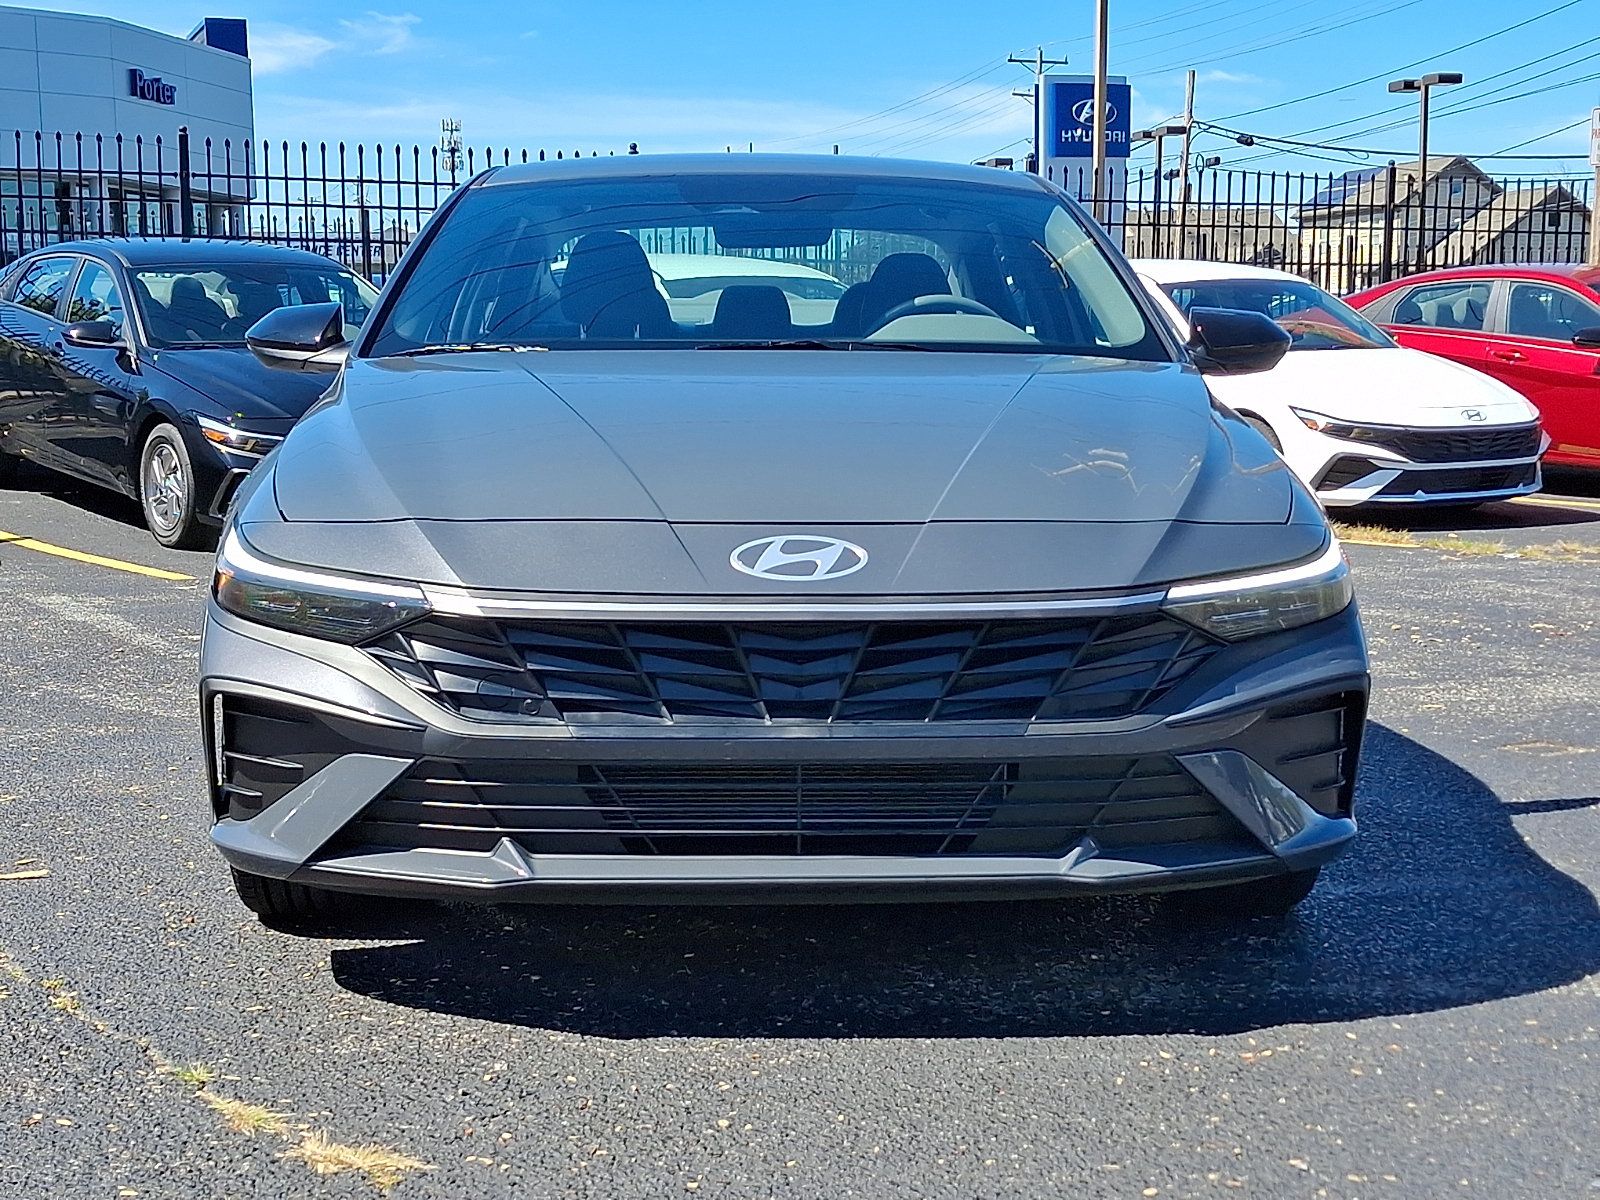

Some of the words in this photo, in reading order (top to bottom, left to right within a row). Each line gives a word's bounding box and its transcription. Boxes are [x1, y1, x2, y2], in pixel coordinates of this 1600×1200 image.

[128, 68, 177, 105] Porter
[1061, 130, 1126, 143] HYUDAI
[336, 244, 382, 257] CENER
